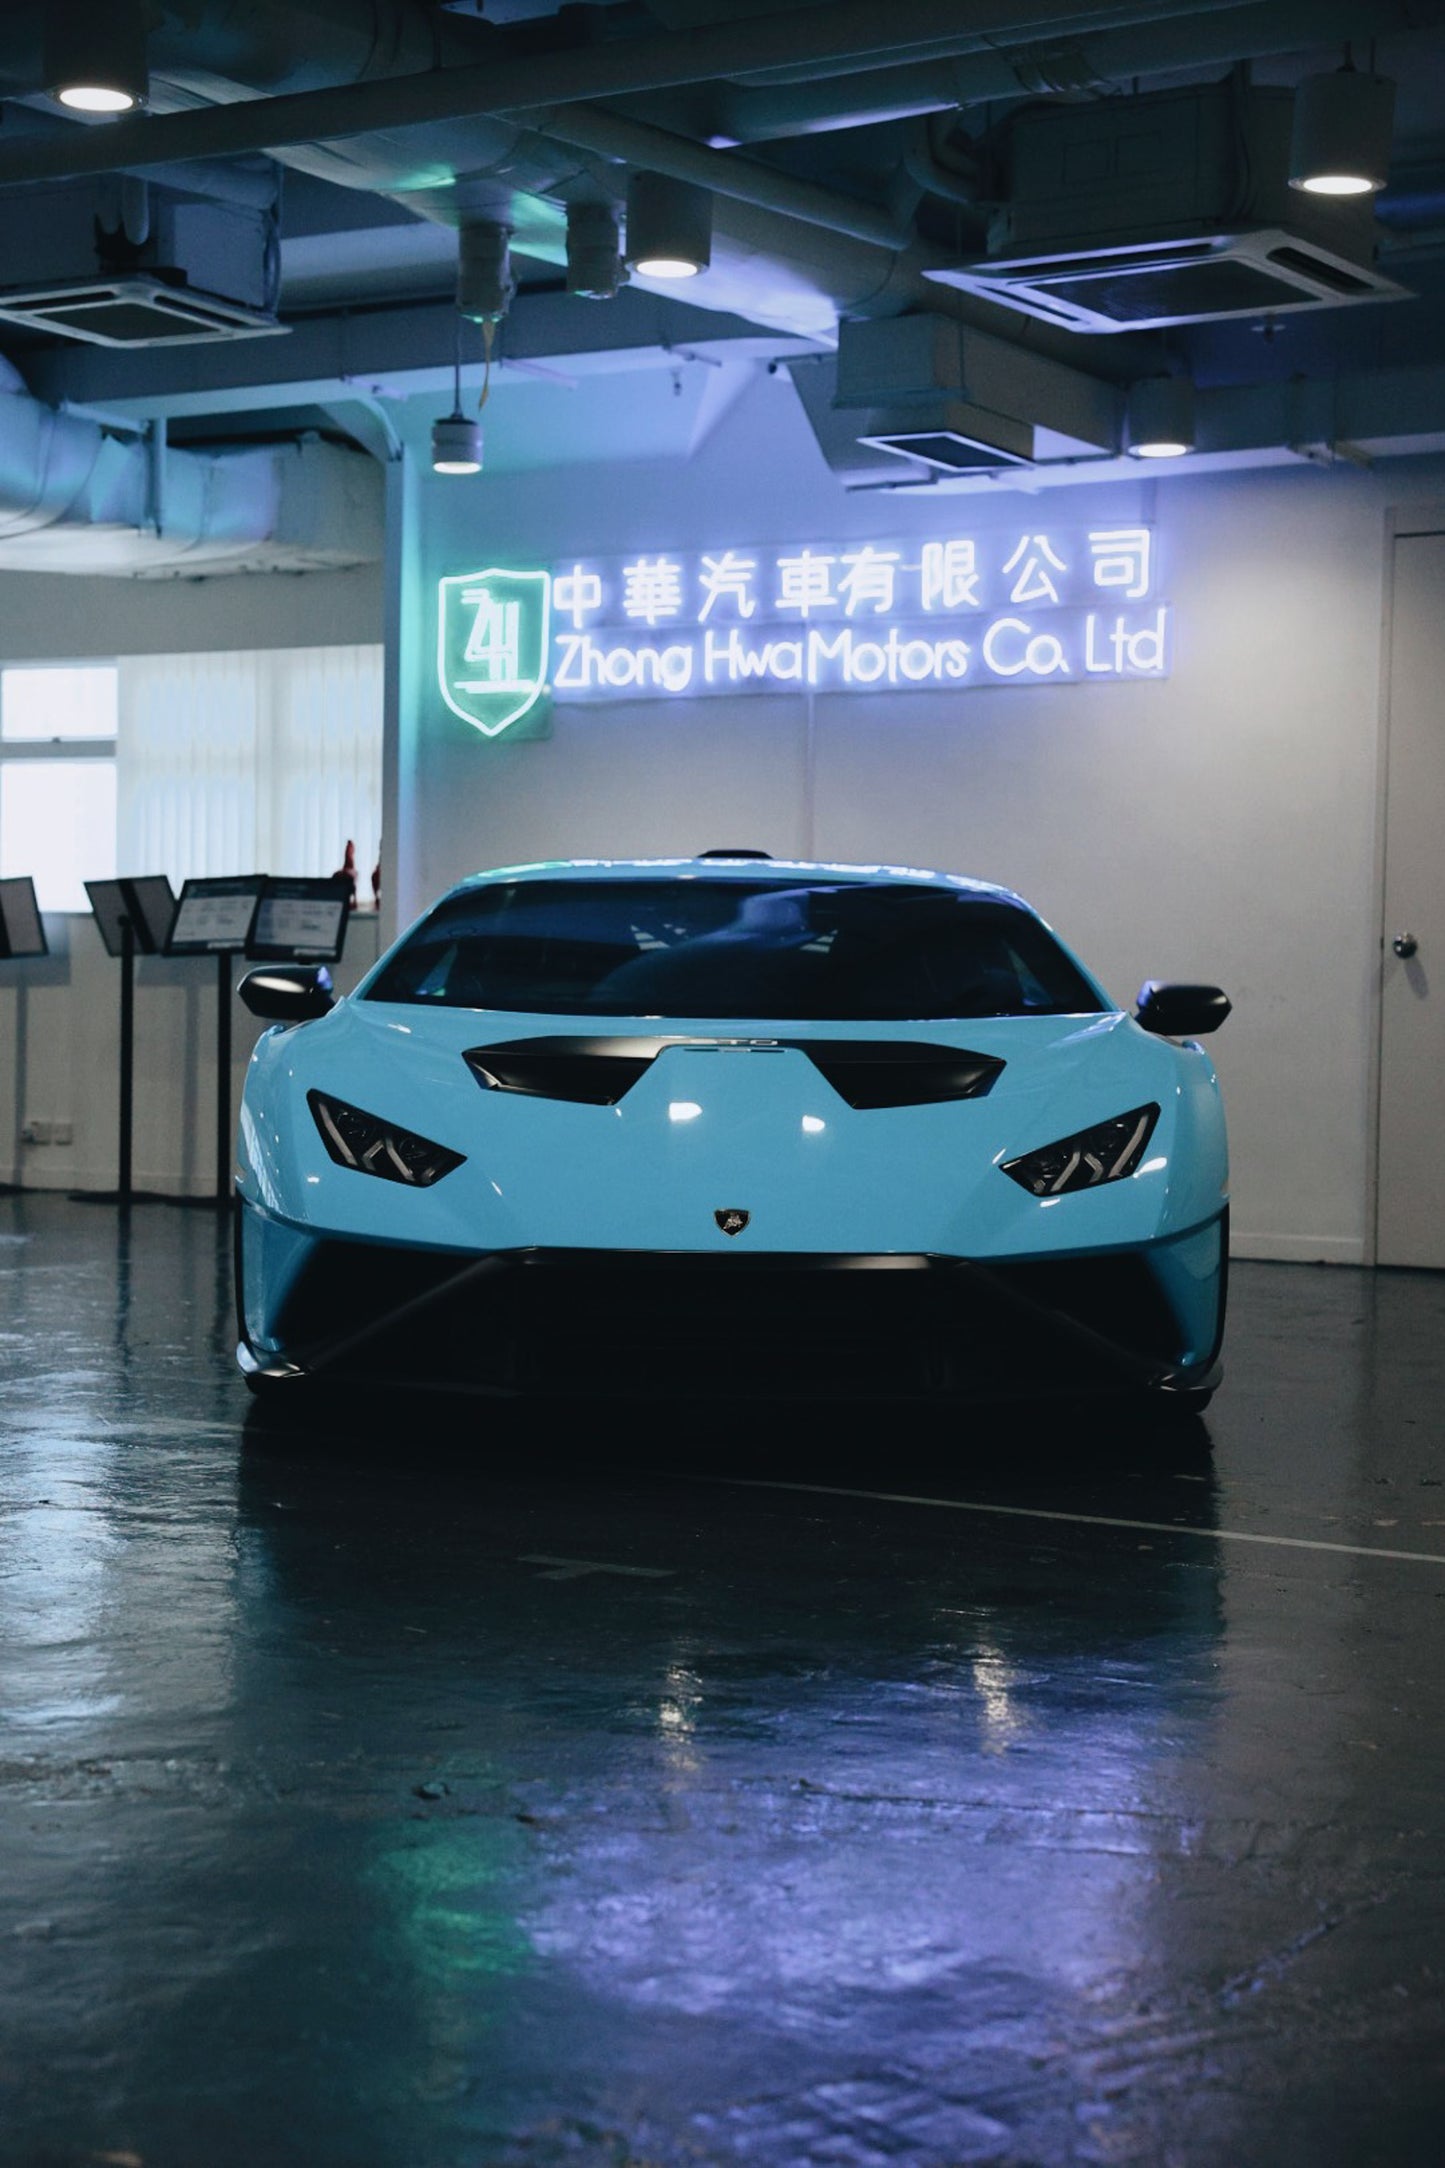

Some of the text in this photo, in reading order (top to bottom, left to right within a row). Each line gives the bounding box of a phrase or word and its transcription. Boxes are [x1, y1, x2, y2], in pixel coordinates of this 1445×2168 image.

[553, 529, 1152, 629] 中華汽車有限公司
[553, 634, 693, 692] Zhong
[704, 628, 804, 682] Hwa
[807, 628, 971, 685] Motors
[1085, 607, 1167, 673] Ltd
